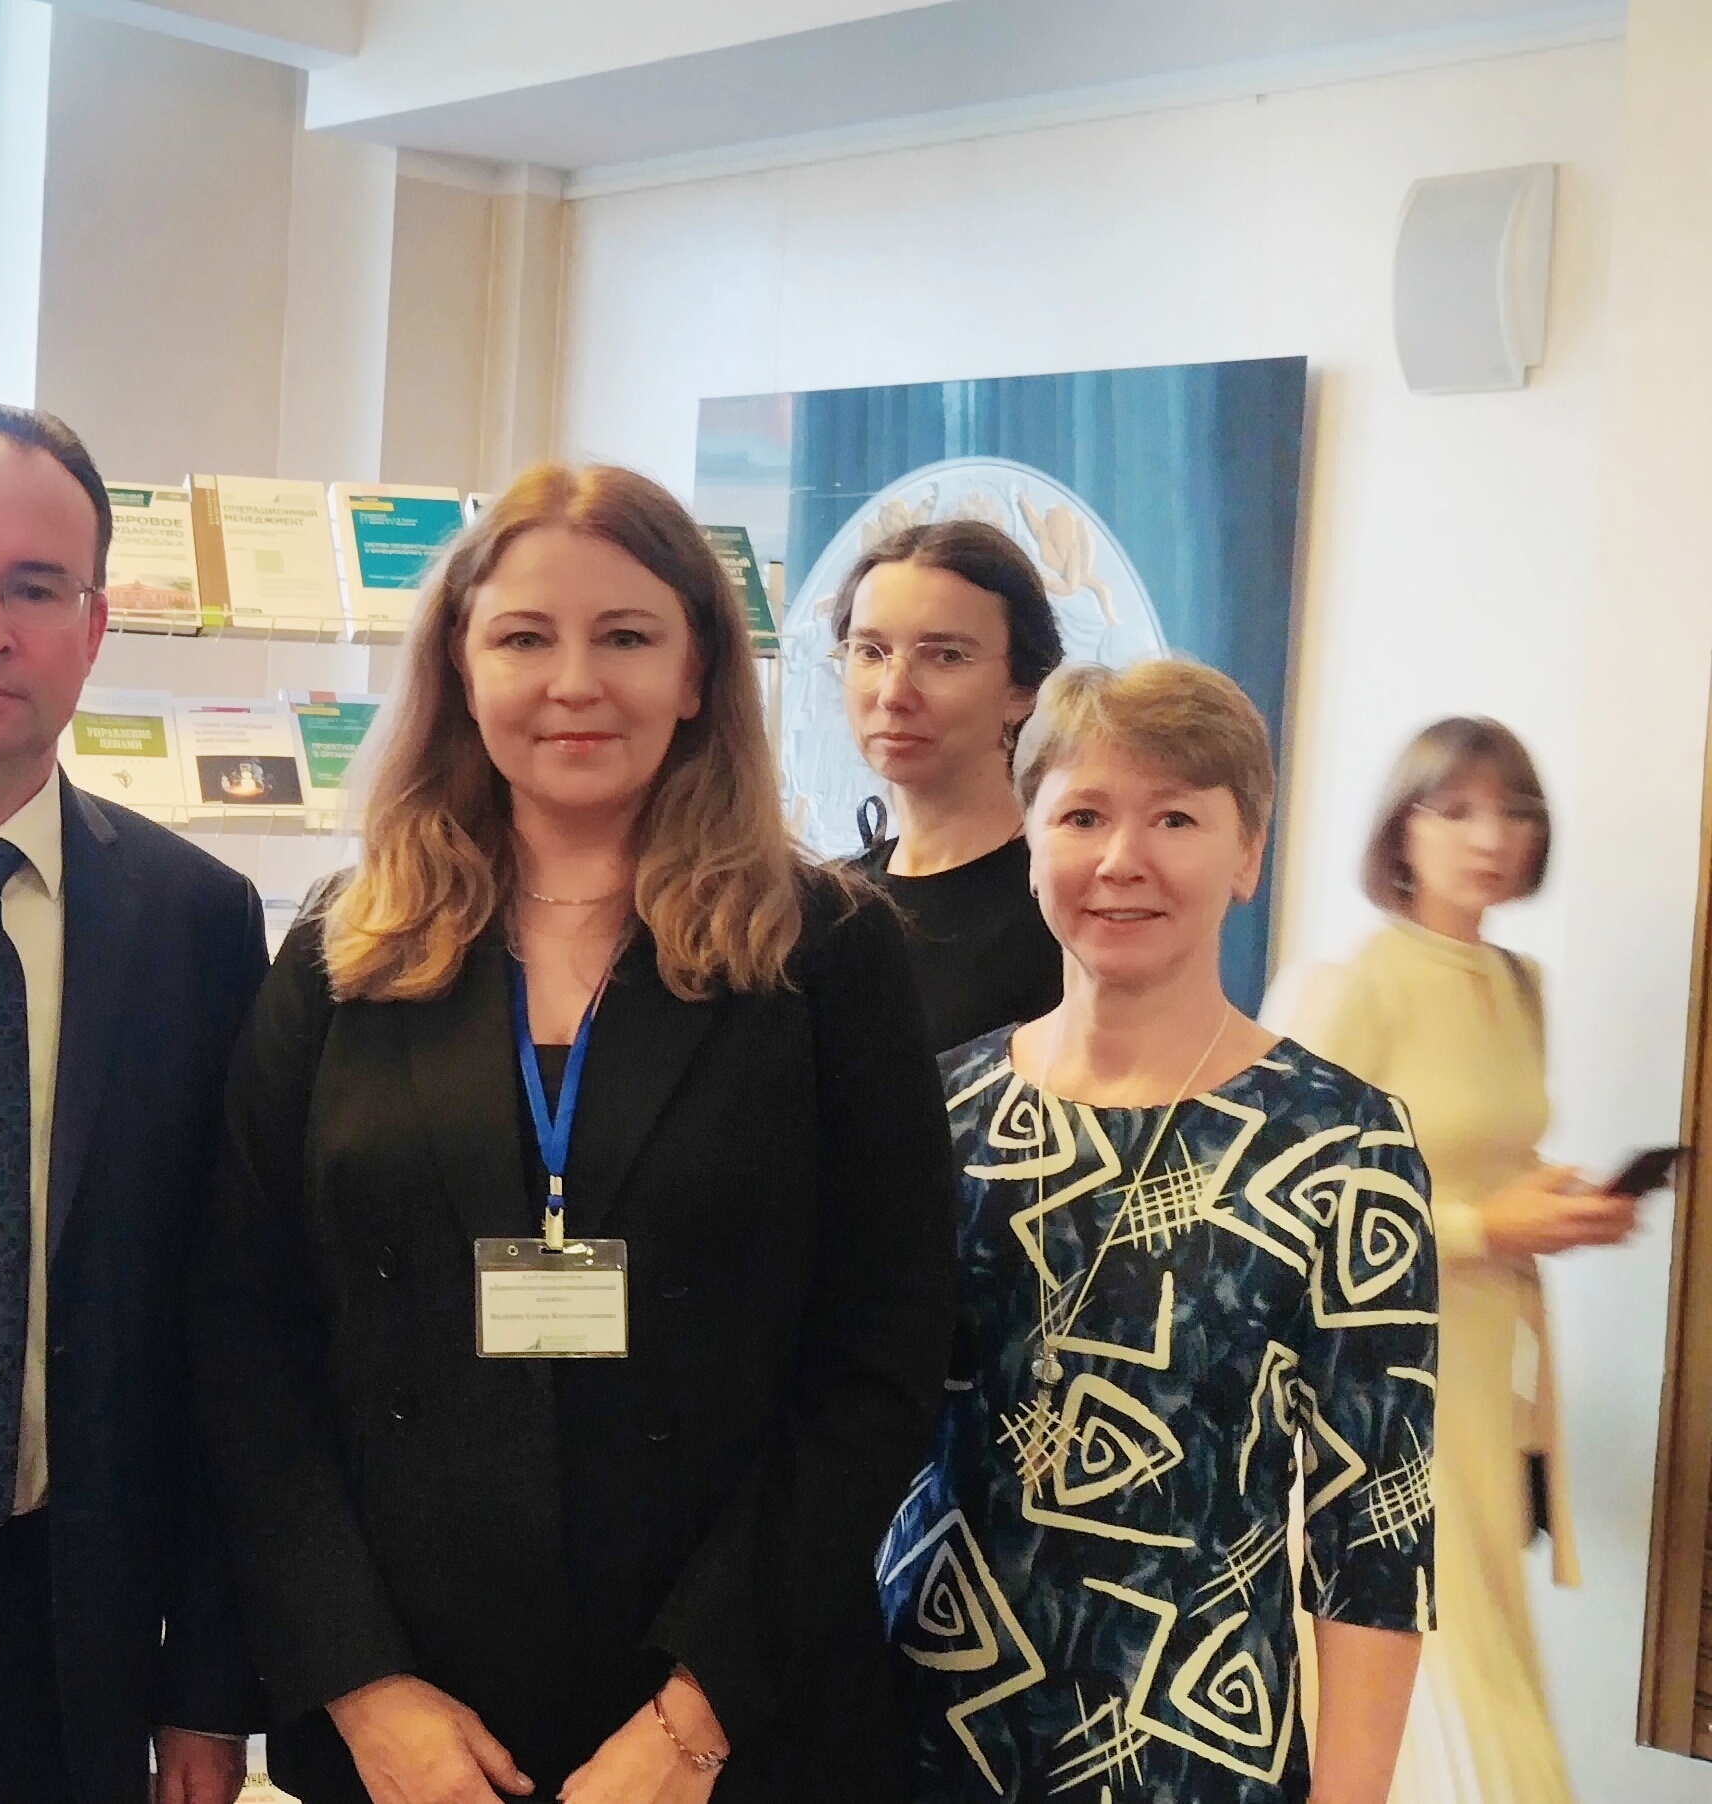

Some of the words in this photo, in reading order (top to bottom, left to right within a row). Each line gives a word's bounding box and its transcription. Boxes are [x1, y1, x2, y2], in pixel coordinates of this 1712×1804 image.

[223, 504, 319, 518] ОПЕРАЦИОННЫЙ
[113, 515, 184, 528] ФРОВОЕ
[224, 513, 305, 526] МЕНЕДЖМЕНТ
[113, 526, 185, 538] УДАРСТВО
[86, 726, 153, 739] УПРАВЛЕНИЕ
[99, 738, 143, 750] ЦЕНАМИ
